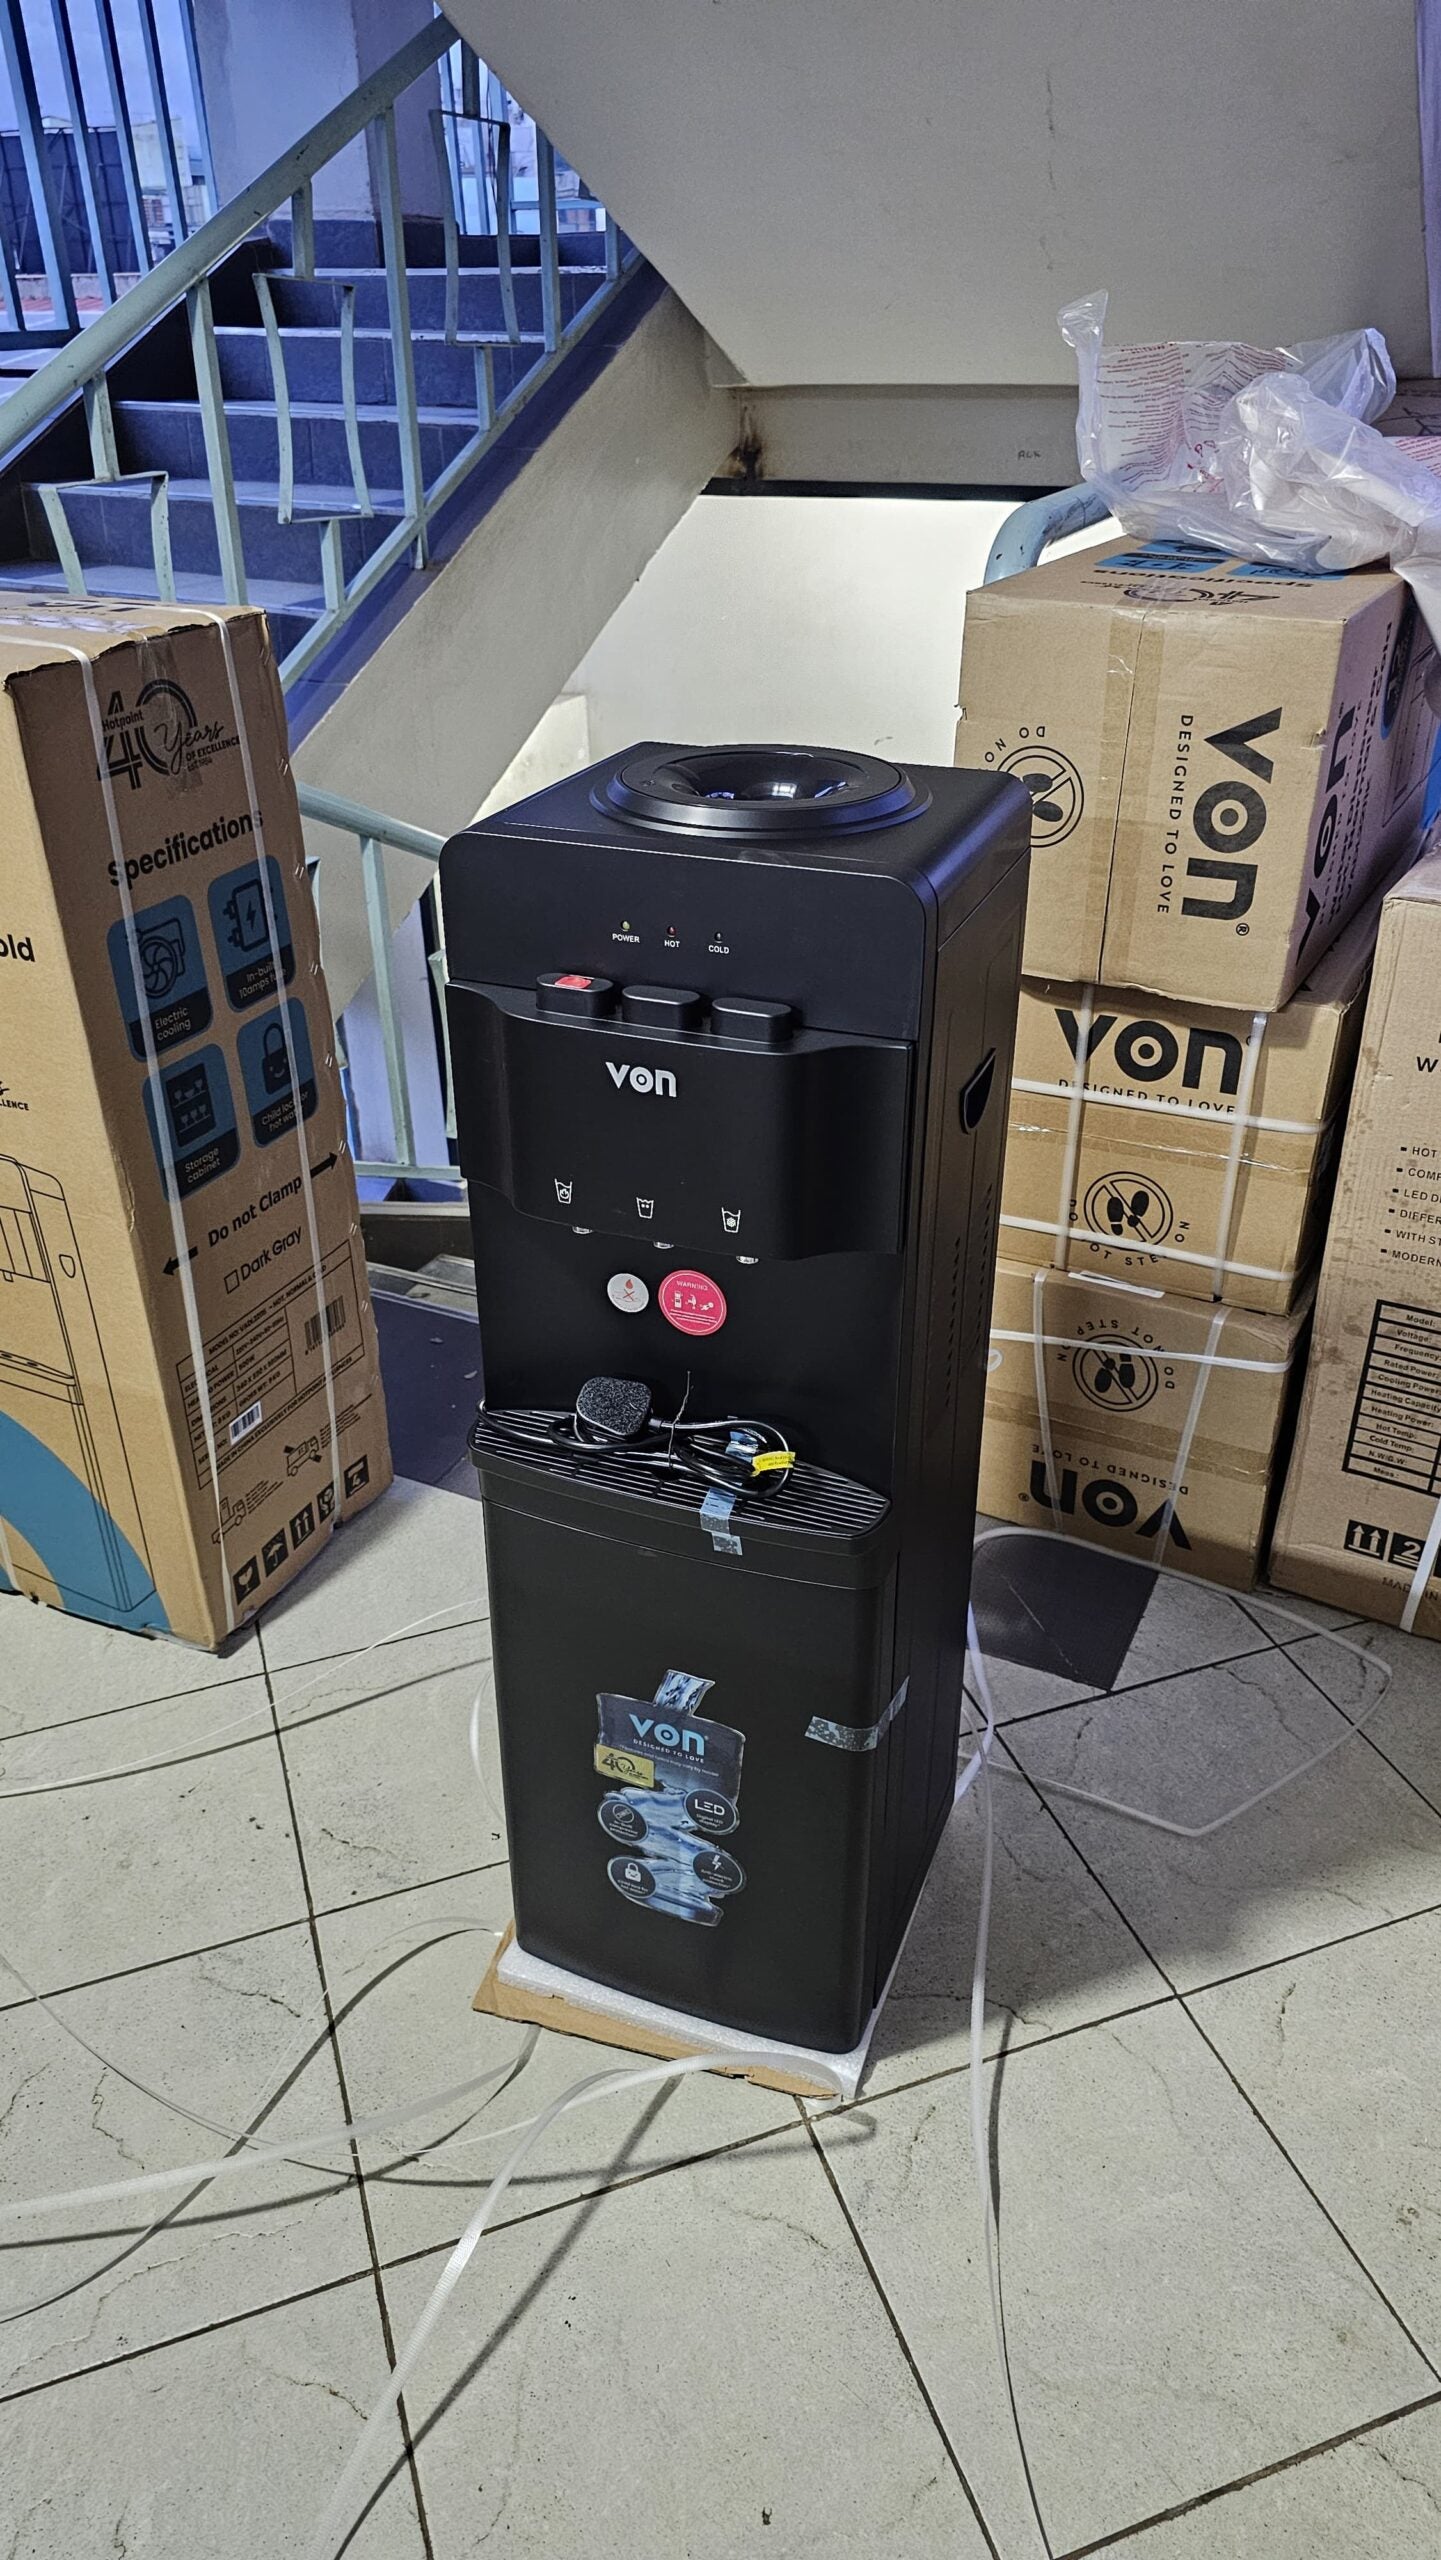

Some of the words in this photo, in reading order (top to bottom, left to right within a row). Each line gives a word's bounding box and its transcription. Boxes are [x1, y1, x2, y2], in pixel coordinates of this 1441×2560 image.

[102, 709, 144, 733] Hotpoint
[1019, 725, 1046, 739] DO
[154, 721, 224, 775] Years
[186, 750, 195, 762] OF
[196, 735, 240, 758] EXCELLENCE
[1168, 715, 1194, 820] DESIGNED
[1164, 829, 1179, 855] TO
[1157, 864, 1175, 914] LOVE
[612, 933, 640, 943] POWER
[664, 940, 680, 948] HOT
[708, 945, 730, 954] COLD
[154, 1008, 189, 1030] Electric
[157, 1018, 191, 1041] cooling
[185, 1147, 220, 1173] Storage
[1412, 1146, 1438, 1159] HOT
[187, 1157, 221, 1184] cabinet
[1403, 1188, 1428, 1200] LED
[208, 1226, 229, 1248] Do
[232, 1205, 258, 1232] not
[259, 1176, 303, 1212] Clamp
[1125, 1253, 1167, 1267] STE
[1174, 1220, 1191, 1243] ON
[1395, 1229, 1426, 1244] WITH
[240, 1248, 273, 1282] Dark
[271, 1225, 301, 1256] Gray
[676, 1280, 709, 1291] WARNING
[1076, 1319, 1119, 1336] STEP
[1406, 1314, 1436, 1328] Model:
[1397, 1329, 1432, 1343] Voltage:
[1164, 1365, 1175, 1390] DO
[1384, 1359, 1409, 1371] Rated
[1410, 1366, 1440, 1379] Power:
[1378, 1373, 1412, 1389] Cooling
[1371, 1389, 1403, 1404] Heating
[1371, 1406, 1404, 1420] Heating
[1404, 1414, 1434, 1428] Power:
[1376, 1423, 1390, 1432] Hot
[1369, 1435, 1388, 1446] Cold
[1079, 1456, 1100, 1470] TO
[633, 1738, 671, 1754] DESIGNED
[672, 1748, 683, 1758] TO
[685, 1754, 705, 1764] LOVE
[694, 1799, 725, 1816] LED
